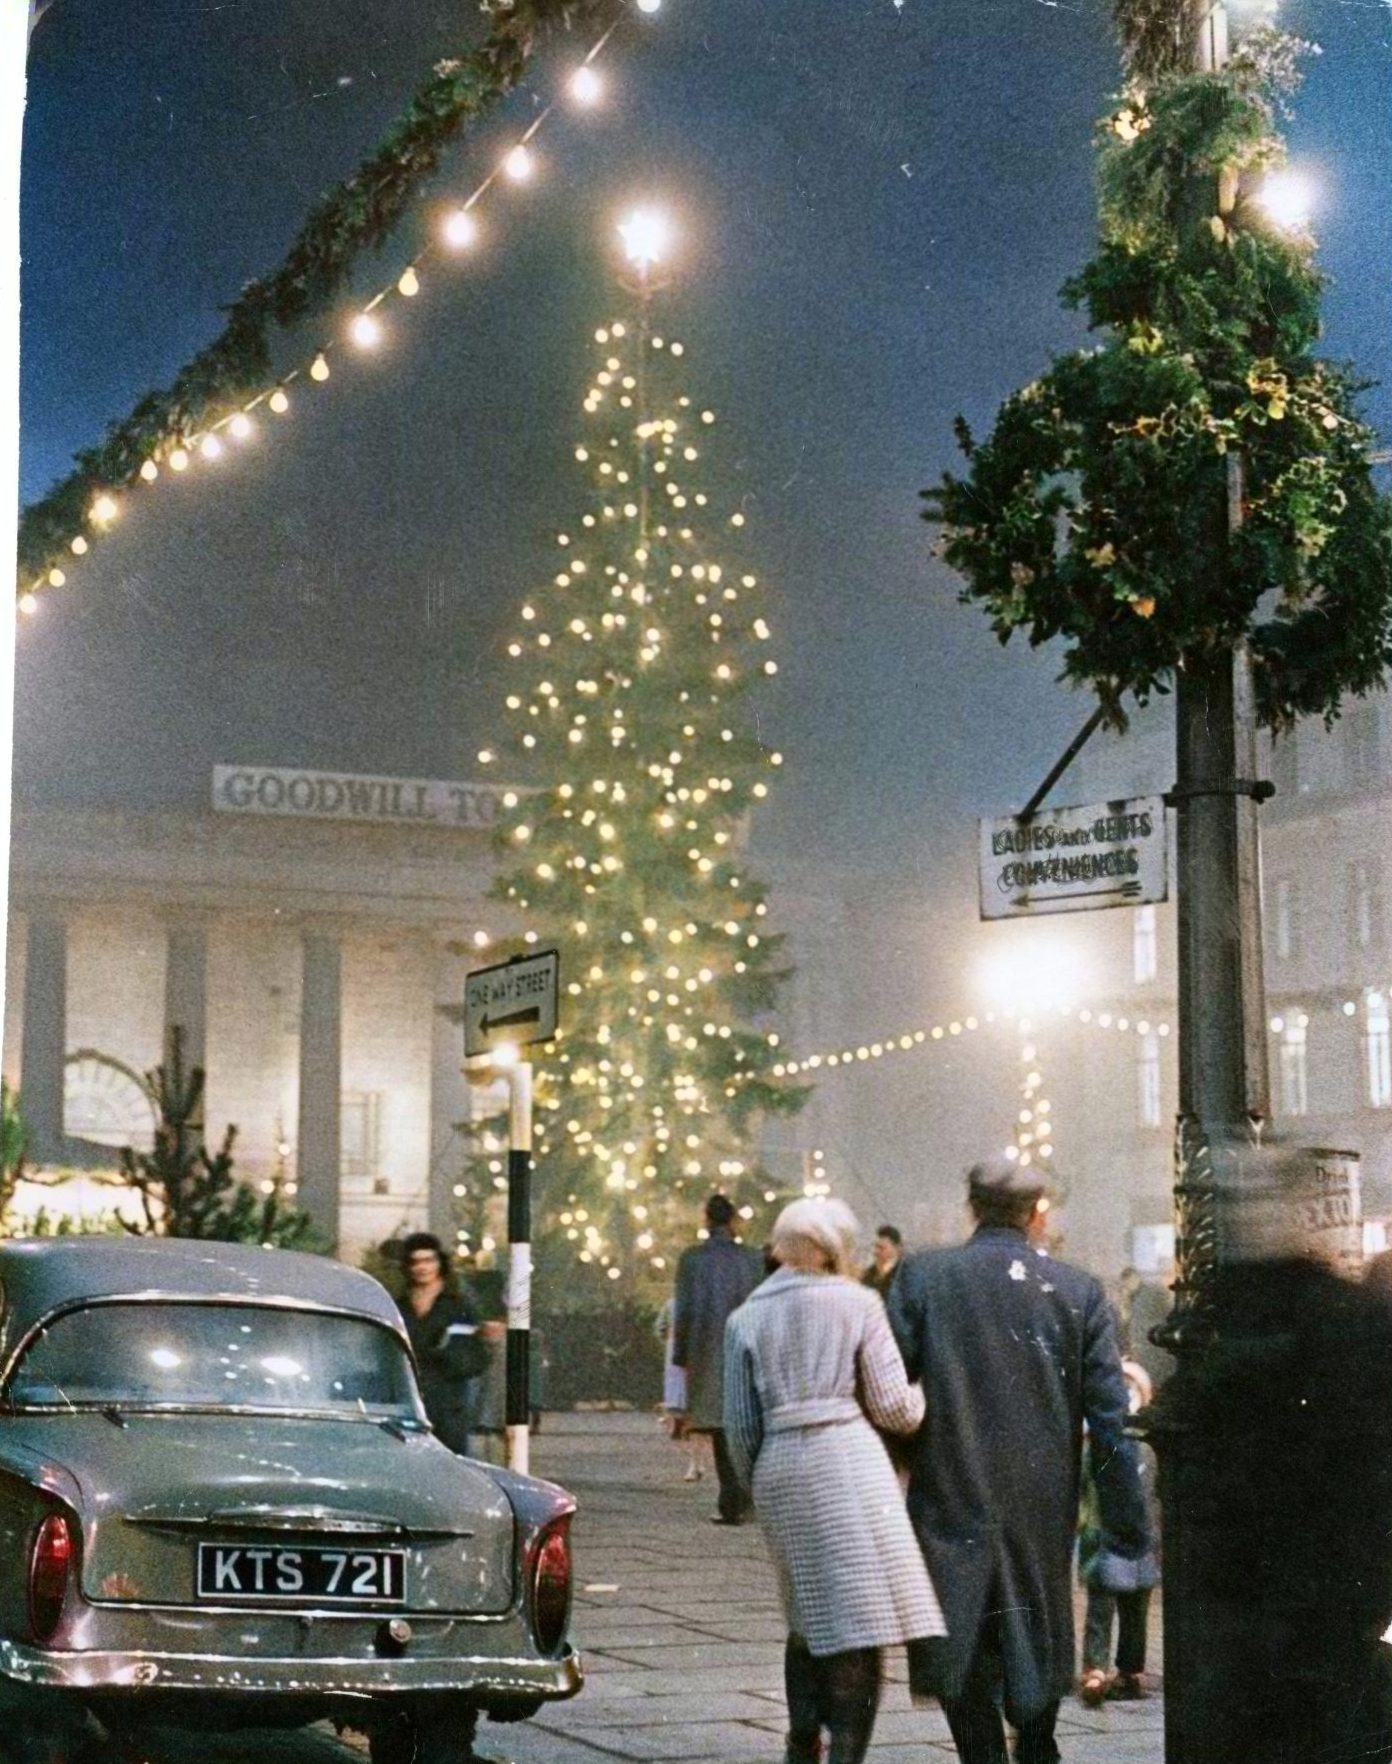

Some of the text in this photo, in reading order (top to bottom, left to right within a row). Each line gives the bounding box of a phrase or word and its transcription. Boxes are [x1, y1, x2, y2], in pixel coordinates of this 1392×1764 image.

[224, 772, 436, 818] GOODWILL
[992, 824, 1056, 856] LADIES
[1093, 812, 1152, 843] GENTS
[470, 968, 551, 1008] ONE WAY STREET
[215, 1550, 392, 1596] KTS 721
